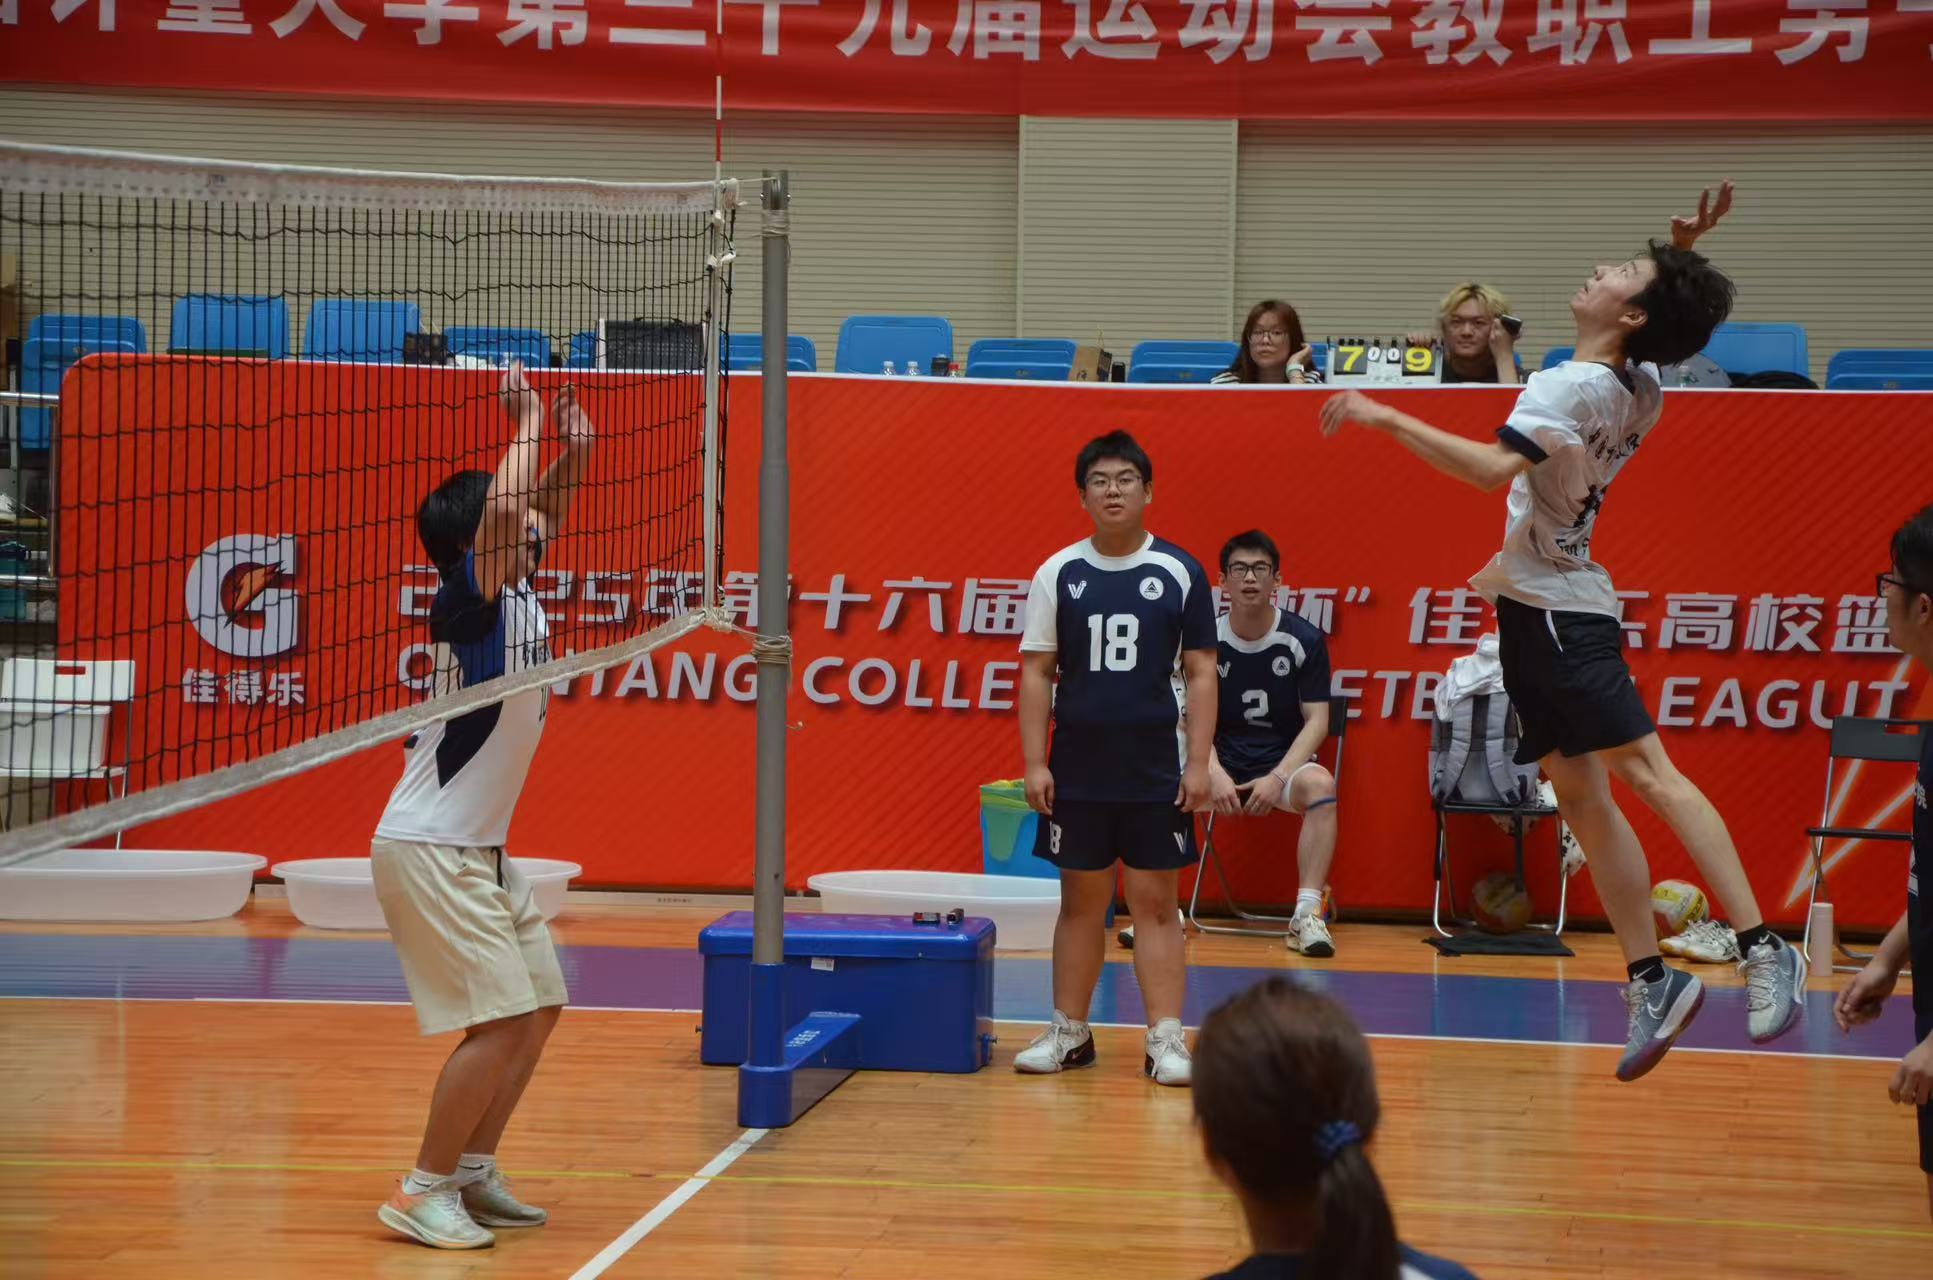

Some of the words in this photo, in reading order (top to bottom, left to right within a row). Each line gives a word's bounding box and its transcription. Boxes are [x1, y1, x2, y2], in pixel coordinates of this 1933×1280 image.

[1338, 346, 1364, 372] 7
[1405, 346, 1432, 372] 9
[185, 533, 298, 657] G
[1088, 613, 1139, 671] 18
[183, 668, 305, 706] 佳得乐
[803, 656, 1056, 710] COLLE
[1242, 689, 1272, 728] 2
